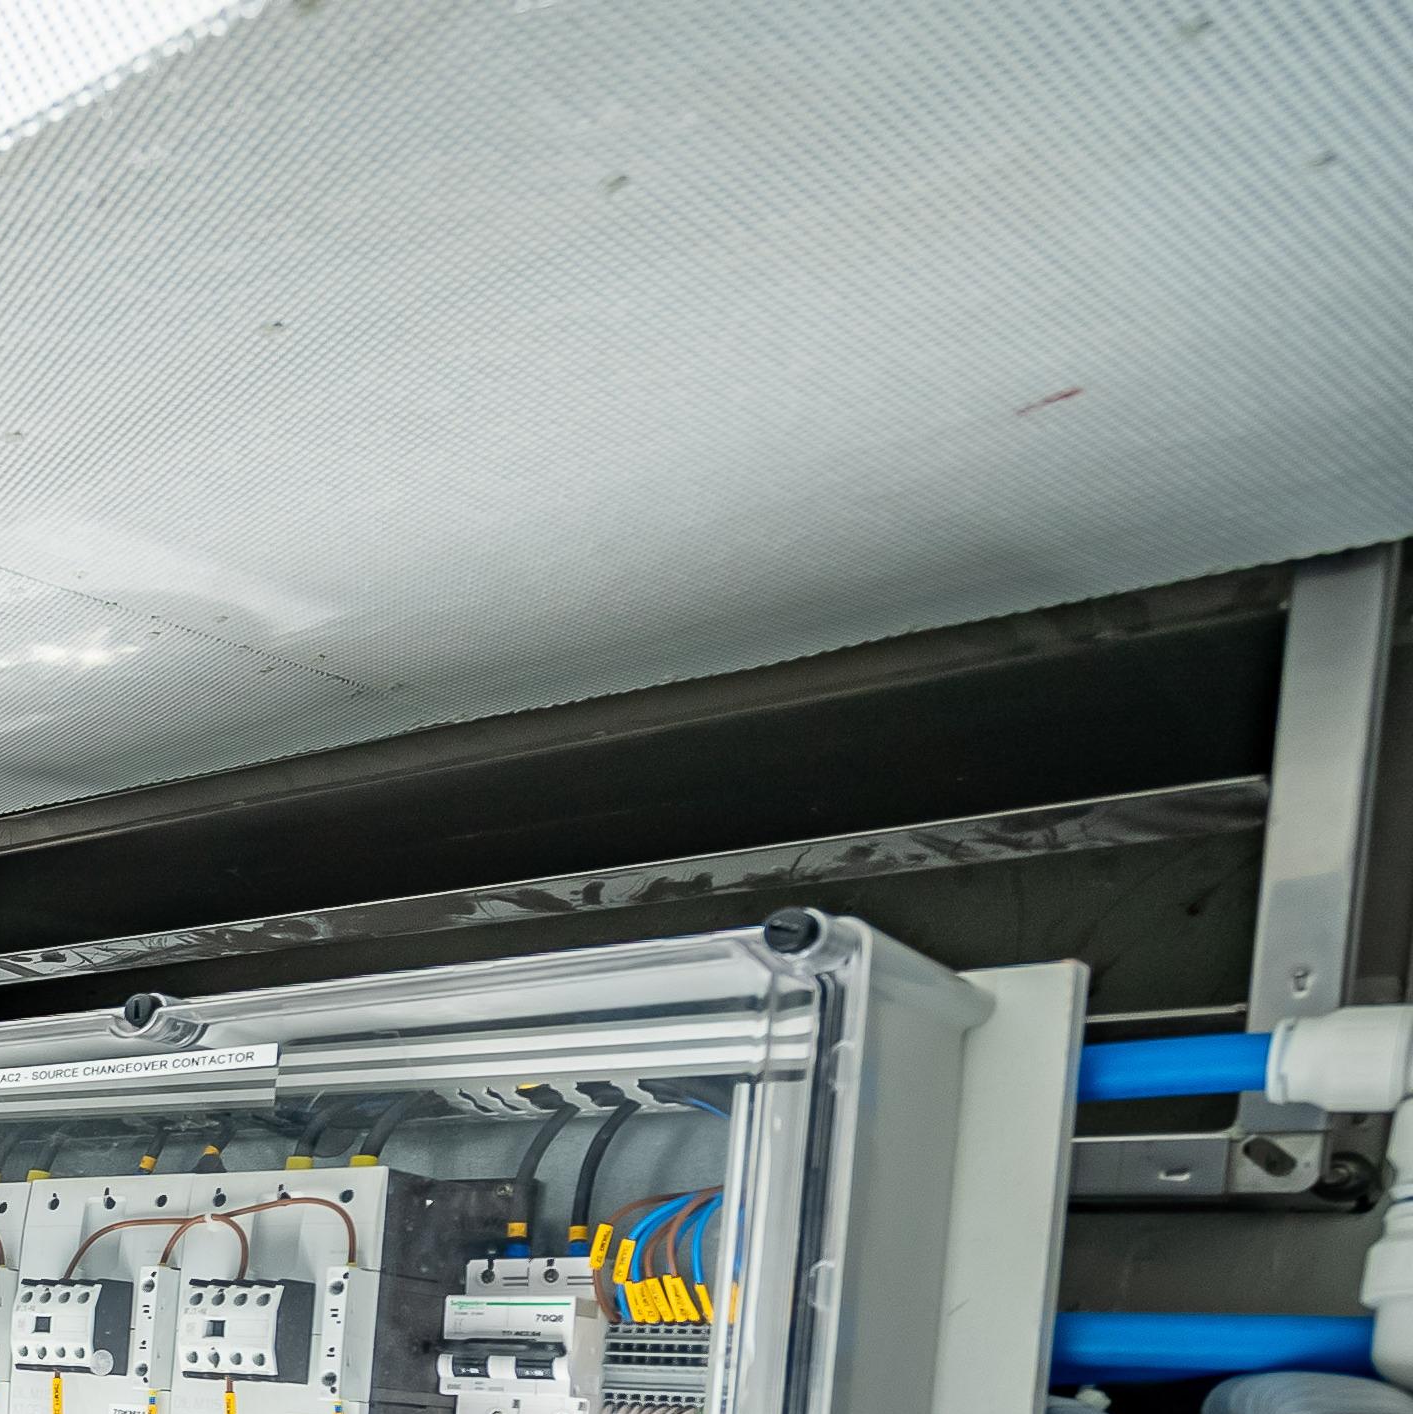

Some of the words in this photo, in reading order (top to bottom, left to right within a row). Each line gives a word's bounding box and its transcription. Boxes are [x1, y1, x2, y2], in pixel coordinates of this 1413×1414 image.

[0, 1072, 21, 1083] AC2
[32, 1068, 78, 1081] SOURCE
[83, 1060, 168, 1076] CHANGEOVER
[172, 1051, 255, 1069] CONTACTOR
